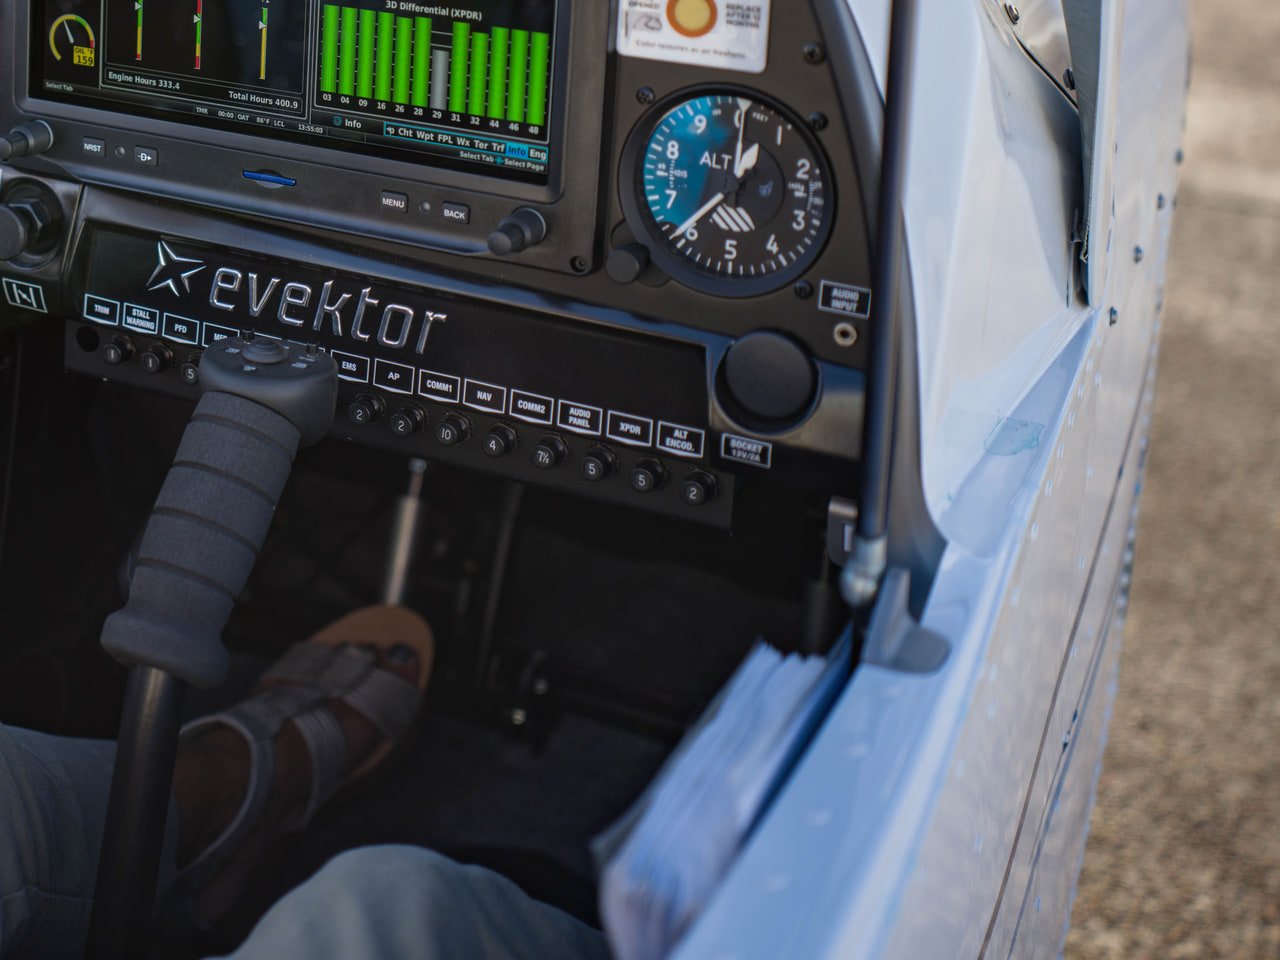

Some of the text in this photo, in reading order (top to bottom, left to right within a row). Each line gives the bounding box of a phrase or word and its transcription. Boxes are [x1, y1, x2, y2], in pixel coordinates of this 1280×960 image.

[386, 0, 482, 21] 3D Differential (XPDR)
[629, 0, 660, 10] OPENED
[726, 3, 761, 14] REPLACE
[77, 55, 94, 66] 159
[108, 71, 180, 89] Engine Hours 333.4
[229, 91, 298, 109] Total Hours 400.9
[323, 94, 332, 102] 03
[377, 102, 386, 110] 16
[395, 105, 404, 113] 26
[432, 111, 442, 119] 29
[451, 114, 461, 122] 31
[345, 118, 361, 129] Info
[470, 117, 480, 125] 32
[489, 120, 499, 128] 44
[695, 115, 707, 134] 9
[509, 123, 519, 131] 46
[83, 142, 101, 153] NRST
[398, 126, 413, 137] Cht
[416, 130, 434, 142] Wpt
[438, 134, 453, 144] FPL
[456, 137, 470, 147] Wx
[474, 140, 488, 150] Ter
[492, 142, 505, 153] Trf
[509, 145, 526, 156] Info
[529, 149, 547, 161] Eng
[667, 141, 679, 159] 8
[700, 151, 732, 170] ALT
[796, 159, 810, 179] 2
[382, 197, 405, 208] MENU
[666, 190, 677, 209] 7
[444, 209, 465, 220] BACK
[792, 210, 805, 231] 3
[766, 234, 779, 254] 4
[724, 240, 737, 260] 5
[832, 288, 859, 302] AUDIO
[94, 304, 110, 315] TRIM
[209, 265, 448, 355] evektor
[831, 298, 857, 312] INPUT
[132, 309, 150, 320] STALL
[126, 316, 155, 330] WARNING
[174, 324, 187, 334] PFD
[342, 361, 356, 371] EMS
[188, 369, 194, 378] 5
[388, 372, 400, 380] AP
[426, 380, 452, 392] COMM1
[477, 391, 492, 401] NAV
[518, 400, 545, 414] COMM2
[569, 407, 591, 418] AUDIO
[356, 410, 362, 420] 2
[398, 421, 404, 431] 2
[569, 416, 590, 428] PANEL
[441, 429, 451, 440] 10
[620, 423, 640, 435] XPDR
[673, 429, 688, 439] ALT
[489, 440, 496, 451] 4
[665, 439, 694, 452] ENCOD.
[730, 439, 762, 454] SOCKET
[732, 449, 761, 462] 12V/2A
[589, 464, 596, 475] 5
[638, 475, 645, 486] 5
[689, 489, 696, 500] 2
